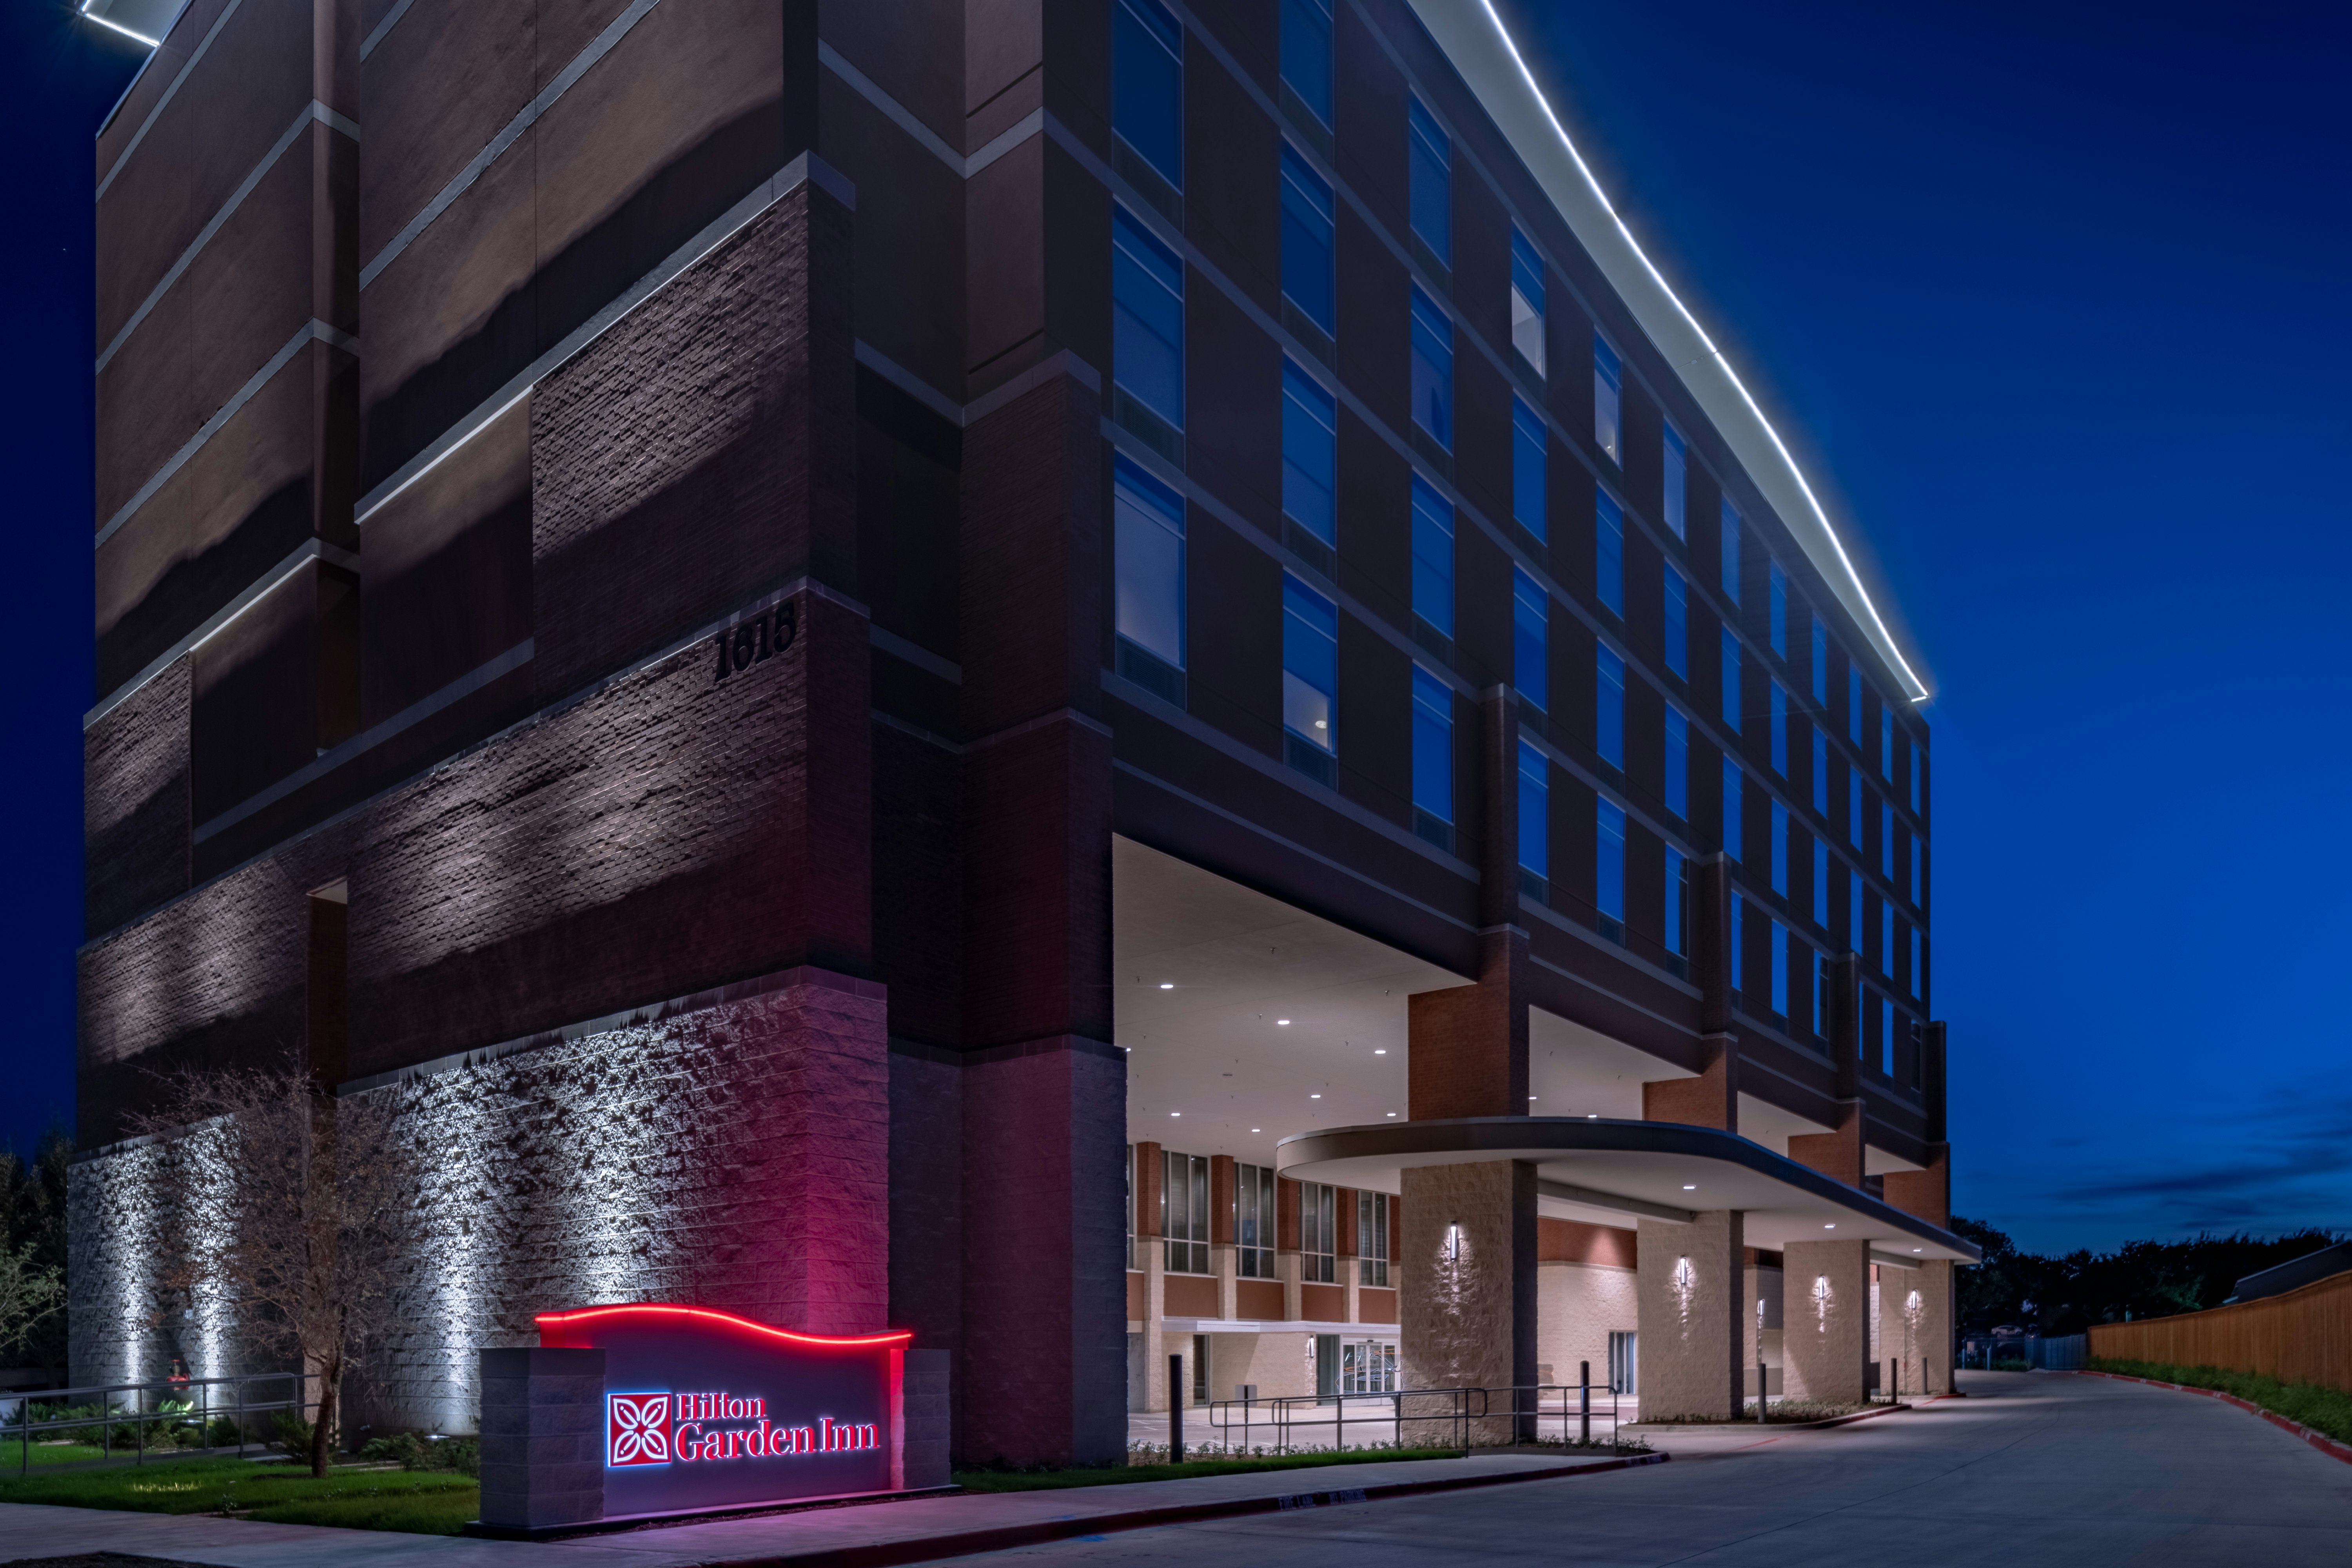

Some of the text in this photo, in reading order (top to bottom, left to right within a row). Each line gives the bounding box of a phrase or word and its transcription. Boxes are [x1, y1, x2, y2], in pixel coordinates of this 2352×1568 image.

[714, 602, 796, 683] 1615
[677, 1393, 767, 1421] Hilton
[675, 1417, 880, 1461] Garden Inn
[1278, 1489, 1367, 1510] FIRE LANE NO PARKING
